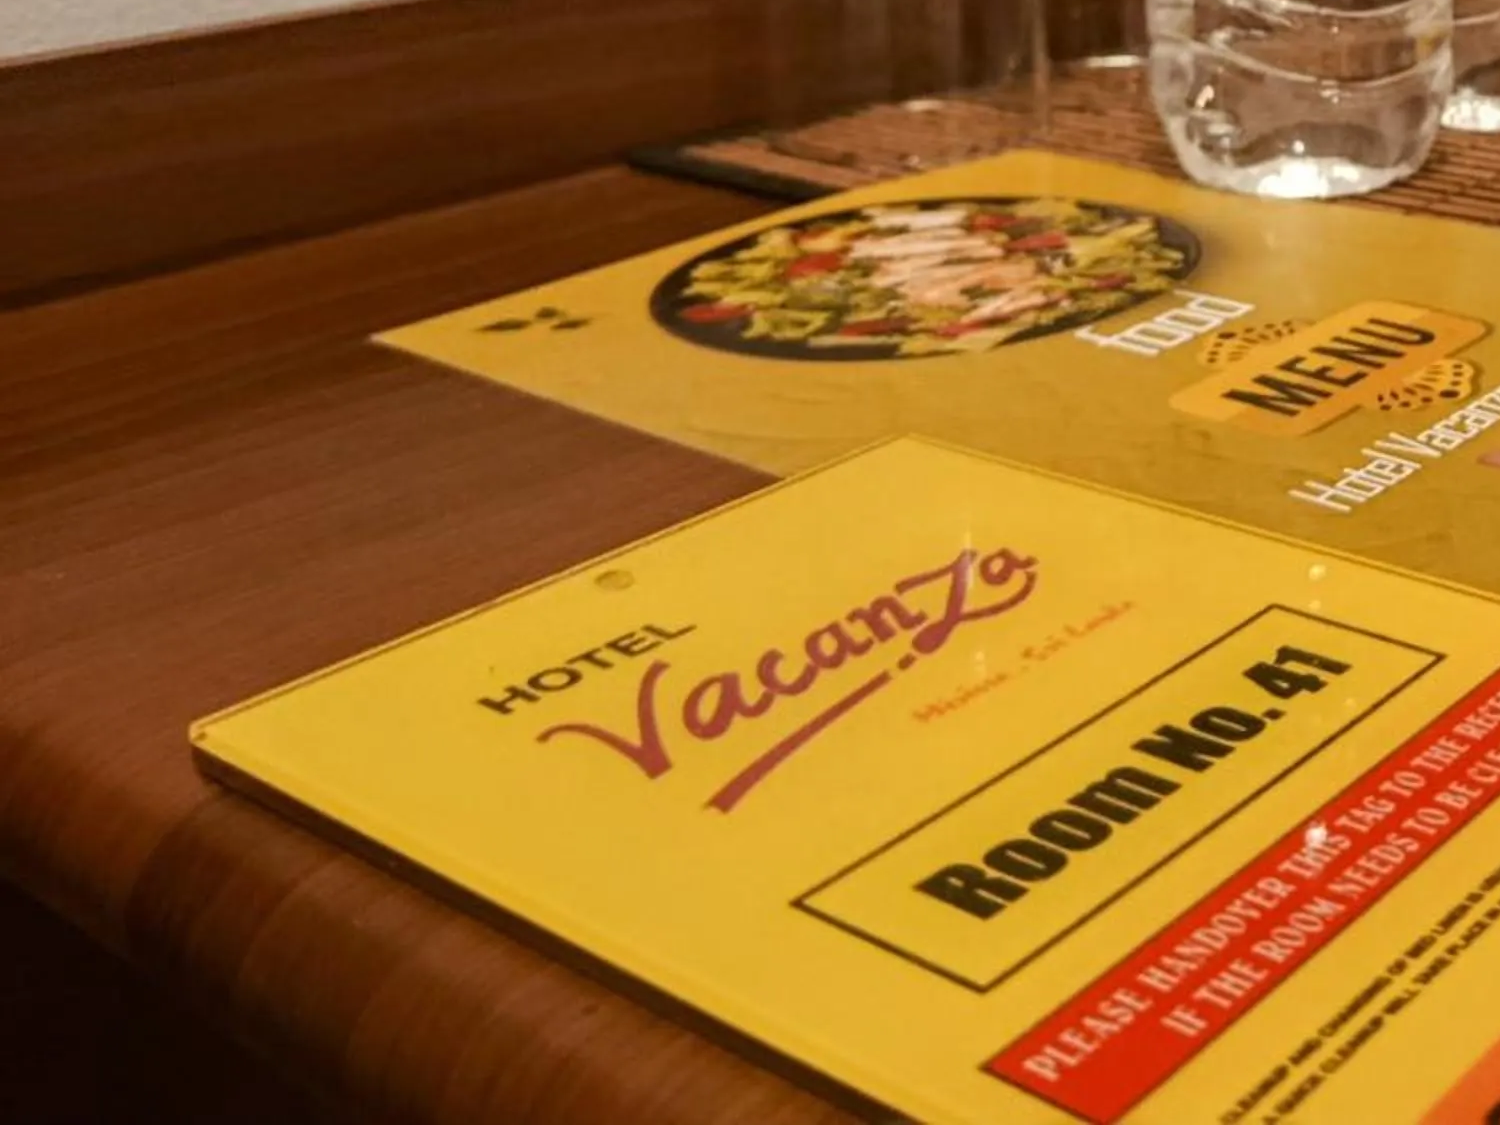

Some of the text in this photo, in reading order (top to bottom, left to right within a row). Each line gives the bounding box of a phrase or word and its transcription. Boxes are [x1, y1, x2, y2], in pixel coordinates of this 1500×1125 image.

[1074, 289, 1256, 356] food
[1221, 318, 1435, 416] MENU
[1288, 447, 1421, 513] Hotel
[477, 621, 697, 715] HOTEL
[913, 766, 1183, 921] Room
[1022, 987, 1153, 1082] PLEASE
[1136, 875, 1297, 994] HANDOVER
[1277, 831, 1351, 880] THIS
[1333, 794, 1397, 834] TAG
[1379, 770, 1427, 798] TO
[1410, 735, 1471, 773] THE
[1160, 1004, 1209, 1038] IF
[1192, 957, 1270, 1010] THE
[1250, 895, 1346, 964] ROOM
[1327, 832, 1420, 901] NEEDS
[1402, 806, 1451, 837] TO
[1434, 780, 1484, 810] BE
[1386, 958, 1408, 977] OF
